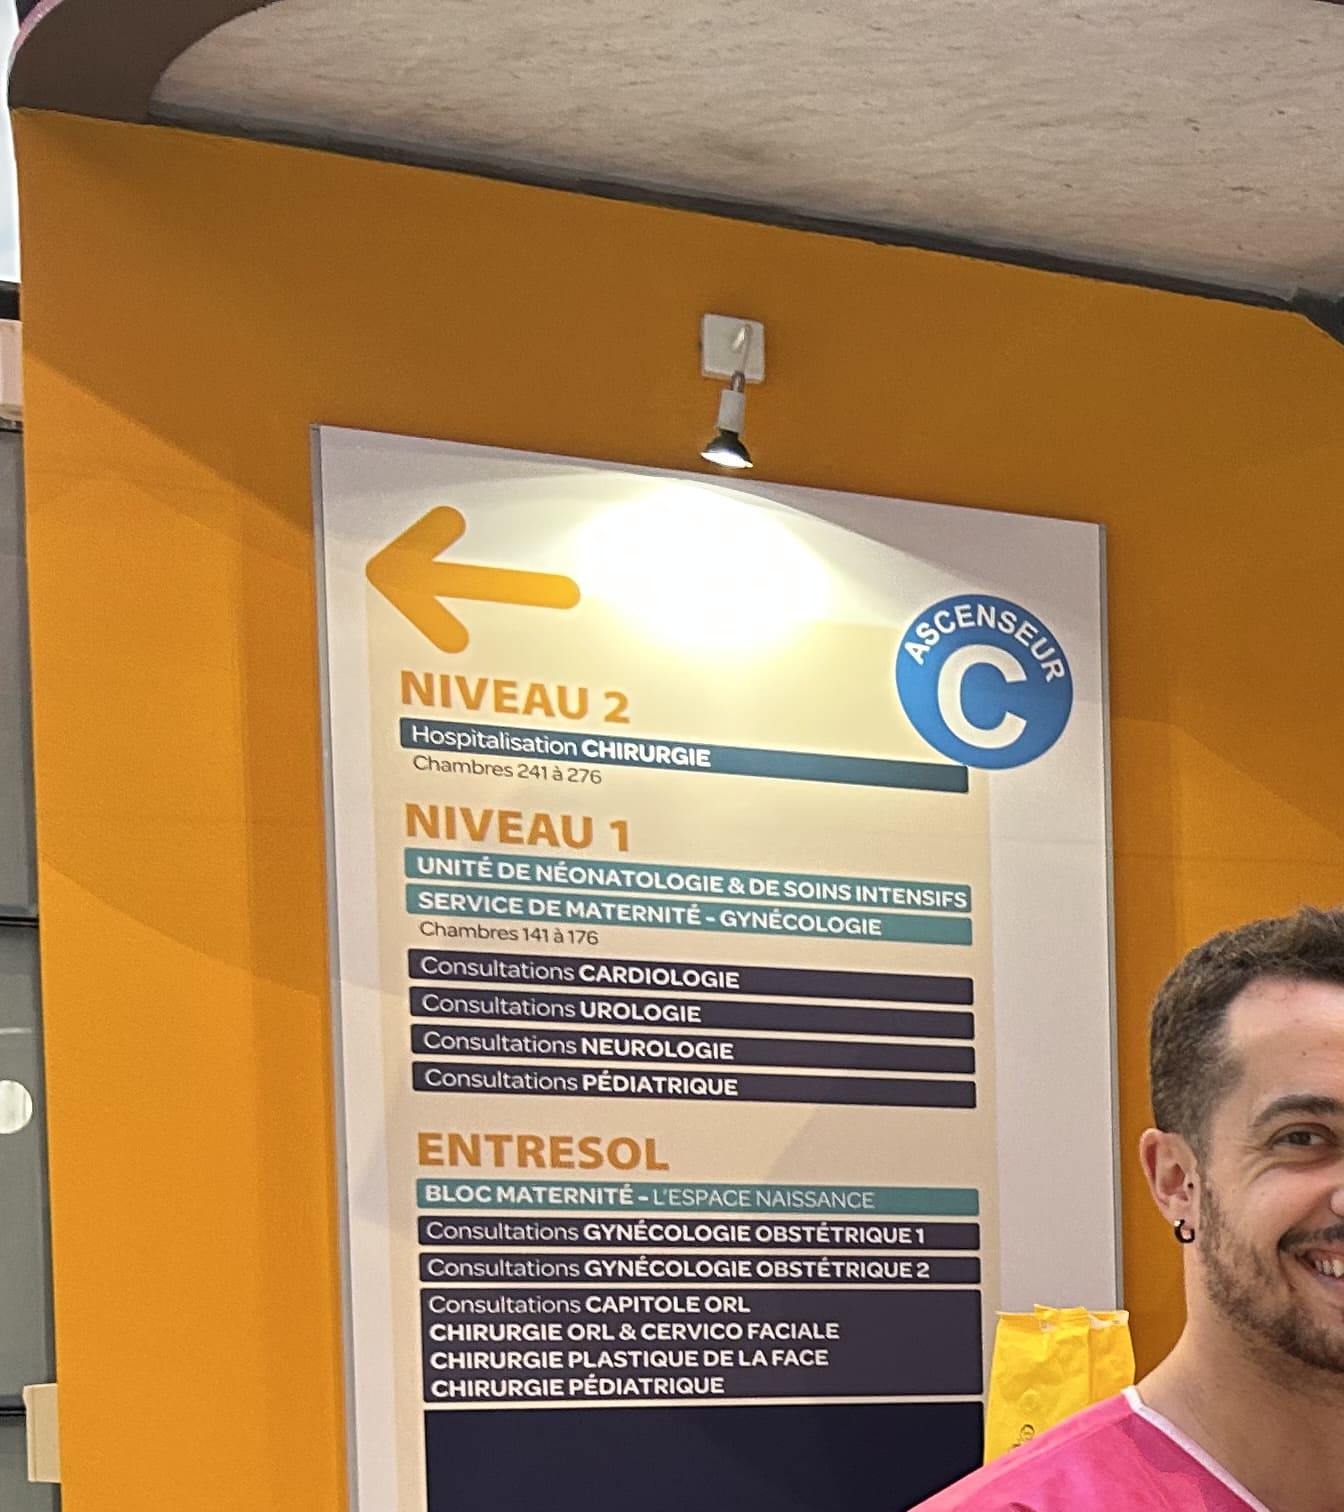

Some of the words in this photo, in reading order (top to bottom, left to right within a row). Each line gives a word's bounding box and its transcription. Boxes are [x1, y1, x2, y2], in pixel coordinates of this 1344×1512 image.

[904, 604, 1065, 683] ASCENSEUR
[400, 669, 589, 720] NIVEAU
[603, 690, 631, 724] 2
[937, 644, 1027, 749] C
[412, 724, 578, 757] Hospitalisation
[582, 738, 712, 768] CHIRURGIE
[413, 753, 514, 779] Chambres
[517, 763, 548, 781] 241
[552, 766, 563, 782] à
[567, 768, 602, 784] 276
[405, 802, 594, 850] NIVEAU
[609, 820, 630, 852] 1
[416, 855, 493, 880] UNITÉ
[498, 861, 532, 882] DE
[535, 860, 724, 894] NÉONATOLOGIE
[727, 876, 746, 895] &
[749, 877, 780, 898] DE
[784, 880, 851, 902] SOINS
[855, 883, 968, 909] INTENSIFS
[418, 890, 524, 915] SERVICE
[528, 899, 562, 918] DE
[565, 902, 701, 926] MATERNITÉ
[719, 908, 883, 936] GYNÉCOLOGIE
[419, 920, 519, 942] Chambres
[522, 926, 550, 944] 141
[553, 927, 564, 945] à
[567, 929, 599, 946] 176
[420, 955, 575, 982] Consultations
[578, 963, 741, 990] CARDIOLOGIE
[421, 993, 577, 1018] Consultations
[580, 1000, 702, 1024] UROLOGIE
[423, 1030, 578, 1055] Consultations
[581, 1036, 735, 1061] NEUROLOGIE
[424, 1067, 579, 1092] Consultations
[582, 1069, 739, 1097] PÉDIATRIQUE
[416, 1131, 670, 1172] ENTRESOL
[425, 1184, 492, 1203] BLOC
[495, 1183, 634, 1206] MATERNITÉ
[653, 1188, 751, 1208] L'ESPACE
[755, 1189, 876, 1210] NAISSANCE
[426, 1220, 580, 1242] Consultations
[583, 1219, 751, 1243] GYNÉCOLOGIE
[755, 1221, 913, 1246] OBSTÉTRIQUE
[915, 1227, 926, 1245] 1
[427, 1257, 581, 1279] Consultations
[584, 1255, 752, 1279] GYNÉCOLOGIE
[755, 1256, 914, 1280] OBSTÉTRIQUE
[915, 1261, 931, 1280] 2
[428, 1295, 581, 1316] Consultations
[585, 1295, 701, 1315] CAPITOLE
[704, 1295, 752, 1315] ORL
[429, 1323, 563, 1342] CHIRURGIE
[566, 1322, 615, 1342] ORL
[618, 1323, 637, 1342] &
[640, 1322, 744, 1342] CERVICO
[747, 1322, 841, 1341] FACIALE
[429, 1351, 564, 1371] CHIRURGIE
[567, 1349, 699, 1370] PLASTIQUE
[703, 1349, 735, 1368] DE
[738, 1349, 769, 1368] LA
[771, 1348, 830, 1367] FACE
[430, 1378, 565, 1399] CHIRURGIE
[568, 1372, 726, 1397] PÉDIATRIQUE
